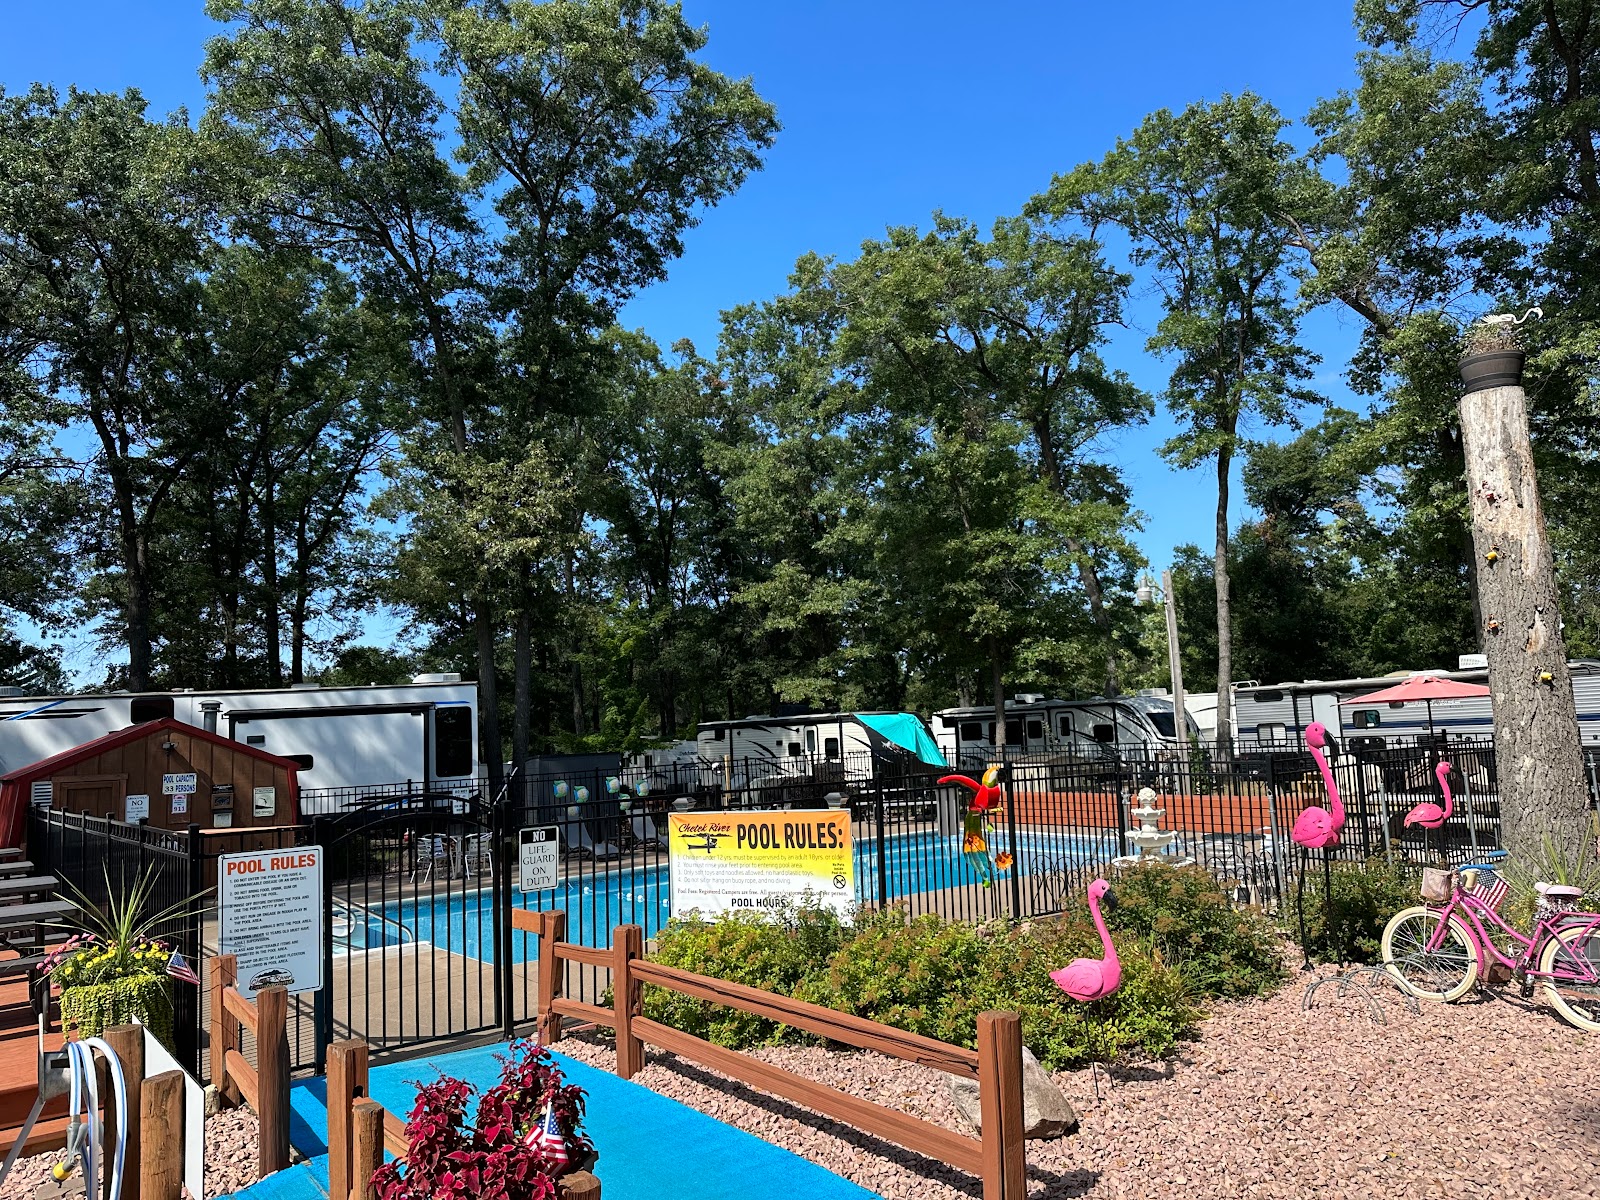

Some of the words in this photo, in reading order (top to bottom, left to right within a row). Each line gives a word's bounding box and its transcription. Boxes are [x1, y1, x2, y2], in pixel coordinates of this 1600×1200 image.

[678, 823, 707, 832] Chetek
[709, 823, 731, 832] River
[533, 831, 545, 842] NO
[737, 824, 780, 849] POOL
[784, 822, 843, 849] RULES:
[529, 845, 549, 854] LIFE-
[228, 860, 265, 875] POOL
[271, 853, 316, 870] RULES
[523, 854, 555, 865] GUARD
[532, 866, 546, 875] ON
[527, 876, 551, 886] DUTY
[731, 898, 754, 907] POOL
